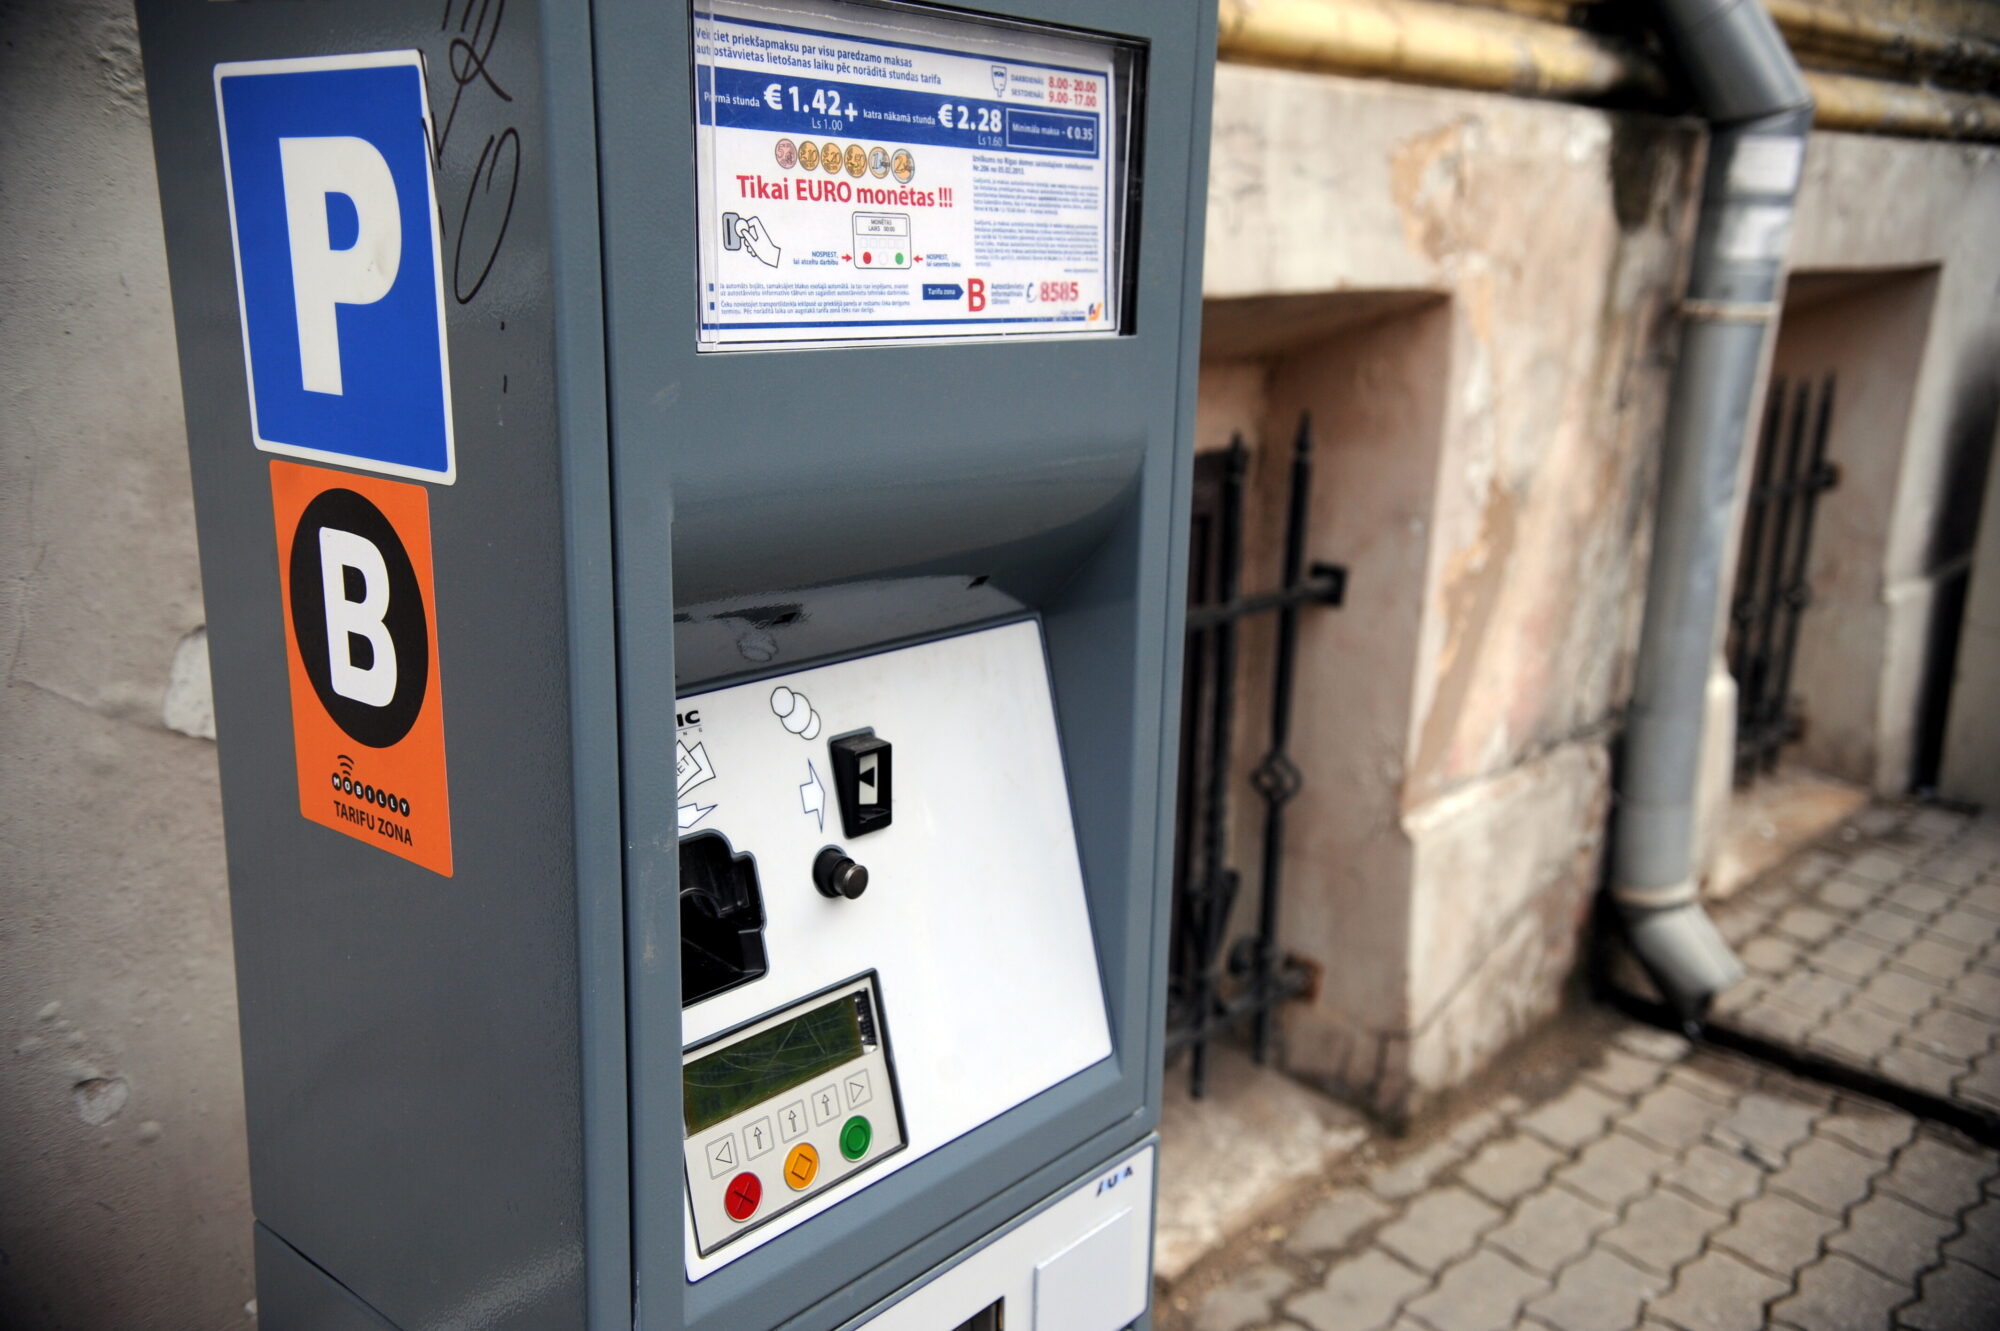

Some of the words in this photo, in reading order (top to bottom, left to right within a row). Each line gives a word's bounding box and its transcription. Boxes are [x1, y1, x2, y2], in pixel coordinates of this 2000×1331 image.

[732, 33, 799, 52] priekšapmaksu
[802, 44, 816, 55] par
[818, 46, 835, 57] visu
[837, 49, 882, 64] paredzamo
[884, 56, 912, 68] maksas
[766, 51, 812, 69] lietošanas
[813, 58, 834, 71] laiku
[836, 62, 851, 74] pēc
[889, 71, 919, 82] stundas
[920, 73, 942, 85] tarifa
[732, 96, 760, 107] stunda
[863, 109, 882, 119] katra
[884, 112, 911, 122] nākamā
[912, 115, 936, 125] stunda
[957, 105, 1002, 133] 2.28
[823, 119, 843, 131] 1.00
[736, 175, 789, 200] Tikai
[796, 179, 852, 203] EURO
[856, 186, 935, 207] monētas
[278, 135, 402, 396] P
[967, 277, 986, 312] B
[1040, 281, 1079, 302] 8585
[319, 526, 398, 708] B
[331, 772, 410, 818] MOBILLY
[333, 800, 375, 831] TARIFU
[377, 817, 413, 847] ZONA
